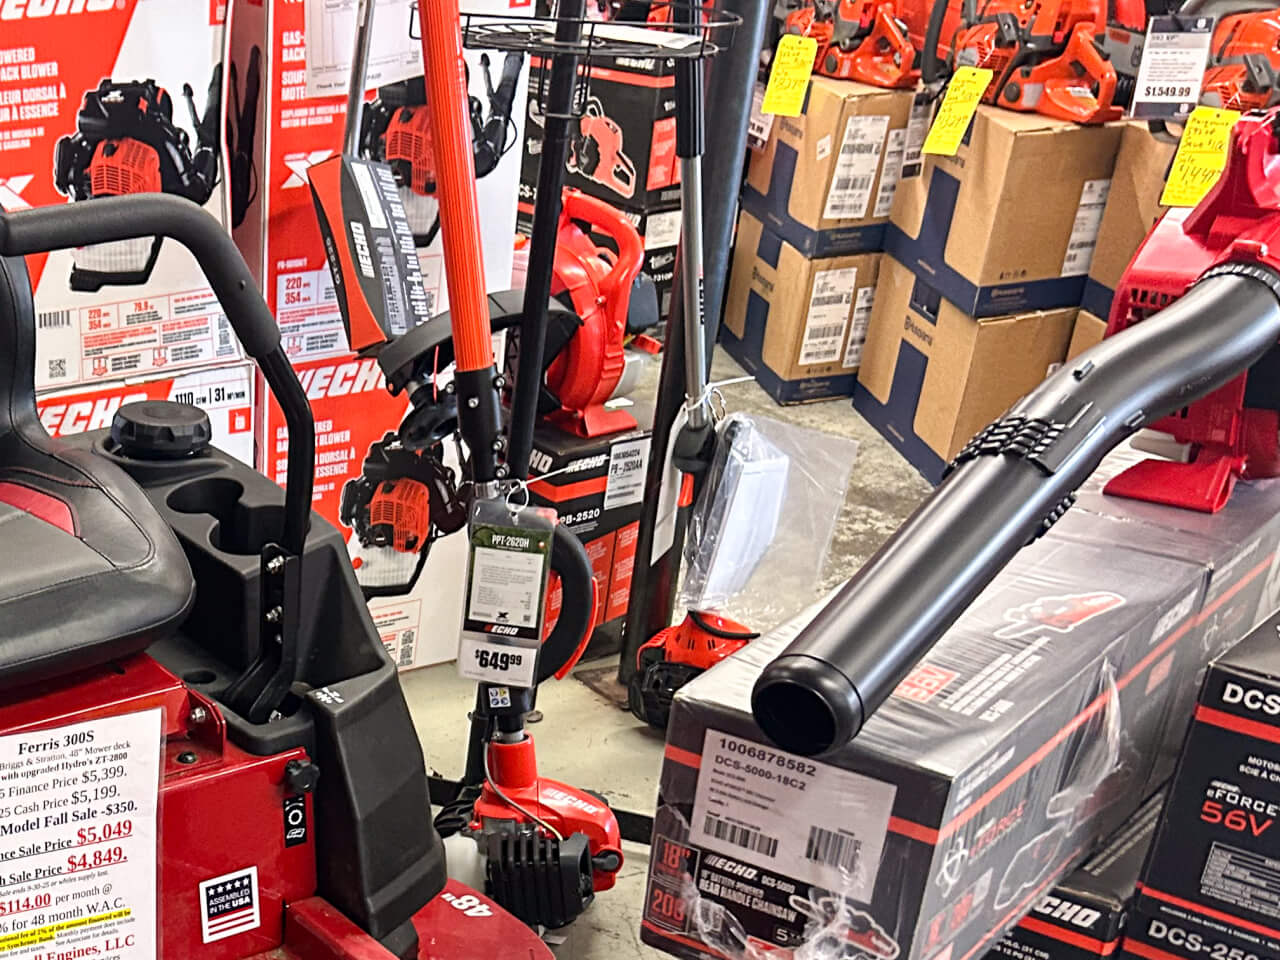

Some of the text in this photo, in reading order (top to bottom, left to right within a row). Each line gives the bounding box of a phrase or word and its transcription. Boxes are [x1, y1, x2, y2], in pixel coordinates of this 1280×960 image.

[282, 48, 306, 62] BACK
[21, 62, 58, 79] BLOWER
[23, 85, 58, 104] DORSAL
[20, 102, 59, 120] ESSENCE
[350, 222, 373, 272] ECHO
[286, 277, 302, 289] 220
[285, 291, 301, 304] 354
[88, 309, 101, 319] 220
[491, 535, 530, 547] PPT-2620H
[489, 625, 518, 635] ECHO
[18, 730, 94, 755] Ferris 300S
[0, 760, 23, 772] Briggs
[26, 757, 33, 765] &
[85, 745, 112, 755] Mower
[113, 740, 131, 750] deck
[719, 738, 817, 777] 1006878582
[1, 771, 19, 781] with
[21, 764, 59, 779] upgraded
[62, 758, 93, 773] Hydro's
[714, 754, 806, 792] DCS-5000-18C2
[9, 780, 49, 798] Finance
[53, 776, 78, 789] Price
[82, 766, 127, 786] $5,399.
[14, 801, 39, 815] Cash
[43, 796, 68, 810] Price
[71, 785, 120, 806] $5,199.
[550, 790, 599, 814] ECHO
[1206, 787, 1278, 816] eFORCE
[0, 819, 40, 837] Model
[44, 812, 68, 828] Fall
[72, 807, 97, 822] Sale
[101, 800, 138, 816] -$350.
[1200, 800, 1273, 837] 56V
[19, 843, 41, 858] Sale
[45, 839, 72, 852] Price
[77, 820, 132, 845] $5,049
[9, 871, 32, 885] Sale
[35, 865, 62, 878] Price
[67, 846, 128, 872] $4,849.
[711, 854, 795, 894] ECHO DCS-5000
[0, 889, 11, 897] Sale
[55, 894, 68, 905] per
[72, 885, 100, 899] month
[103, 883, 112, 894] @
[209, 889, 250, 906] ASSEMBLED
[219, 902, 231, 911] THE
[232, 896, 250, 907] USA
[699, 879, 797, 923] REAR HANDLE CHAINSAW
[12, 920, 28, 931] for
[31, 914, 45, 926] 48
[49, 906, 82, 923] month
[87, 897, 125, 913] W.A.C.
[1034, 896, 1102, 928] CHO
[106, 934, 134, 951] LLC
